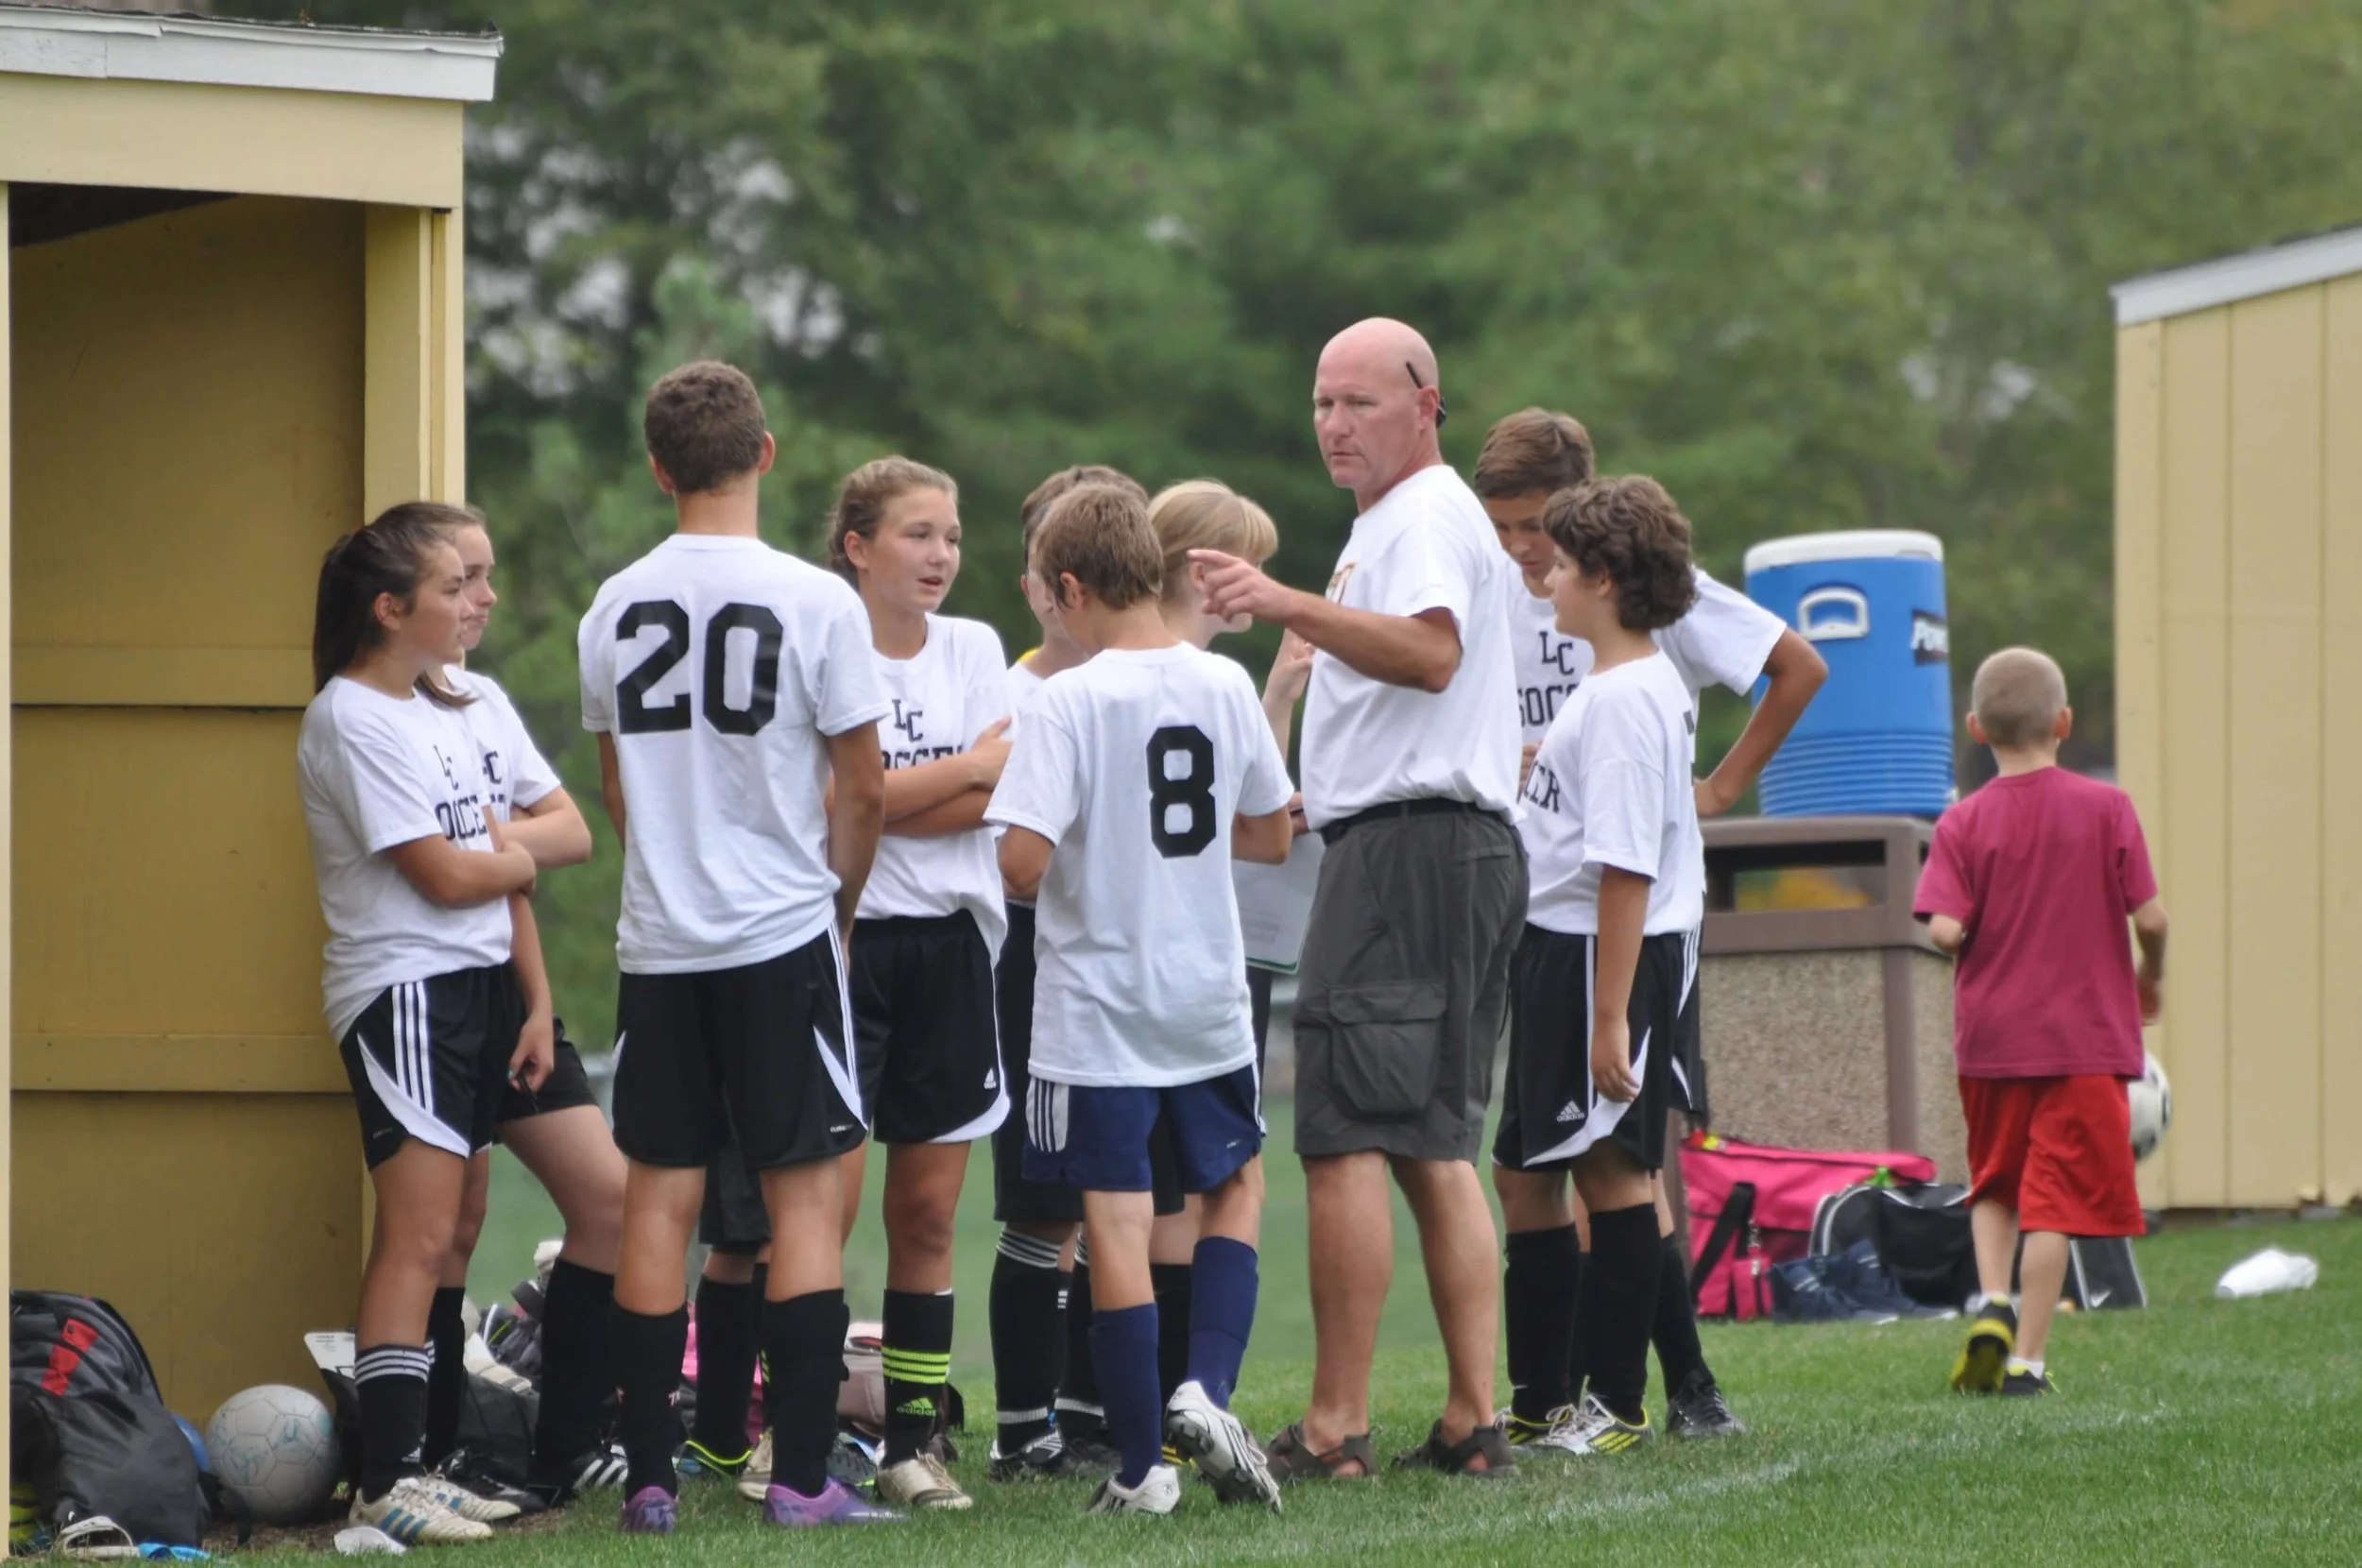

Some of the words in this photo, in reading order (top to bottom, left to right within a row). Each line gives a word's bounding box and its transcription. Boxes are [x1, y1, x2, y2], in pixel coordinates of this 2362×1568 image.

[616, 600, 783, 737] 20
[1539, 630, 1575, 676] LC
[891, 699, 924, 742] LC
[482, 750, 503, 785] C
[1146, 724, 1217, 860] 8
[897, 1404, 937, 1418] adidas
